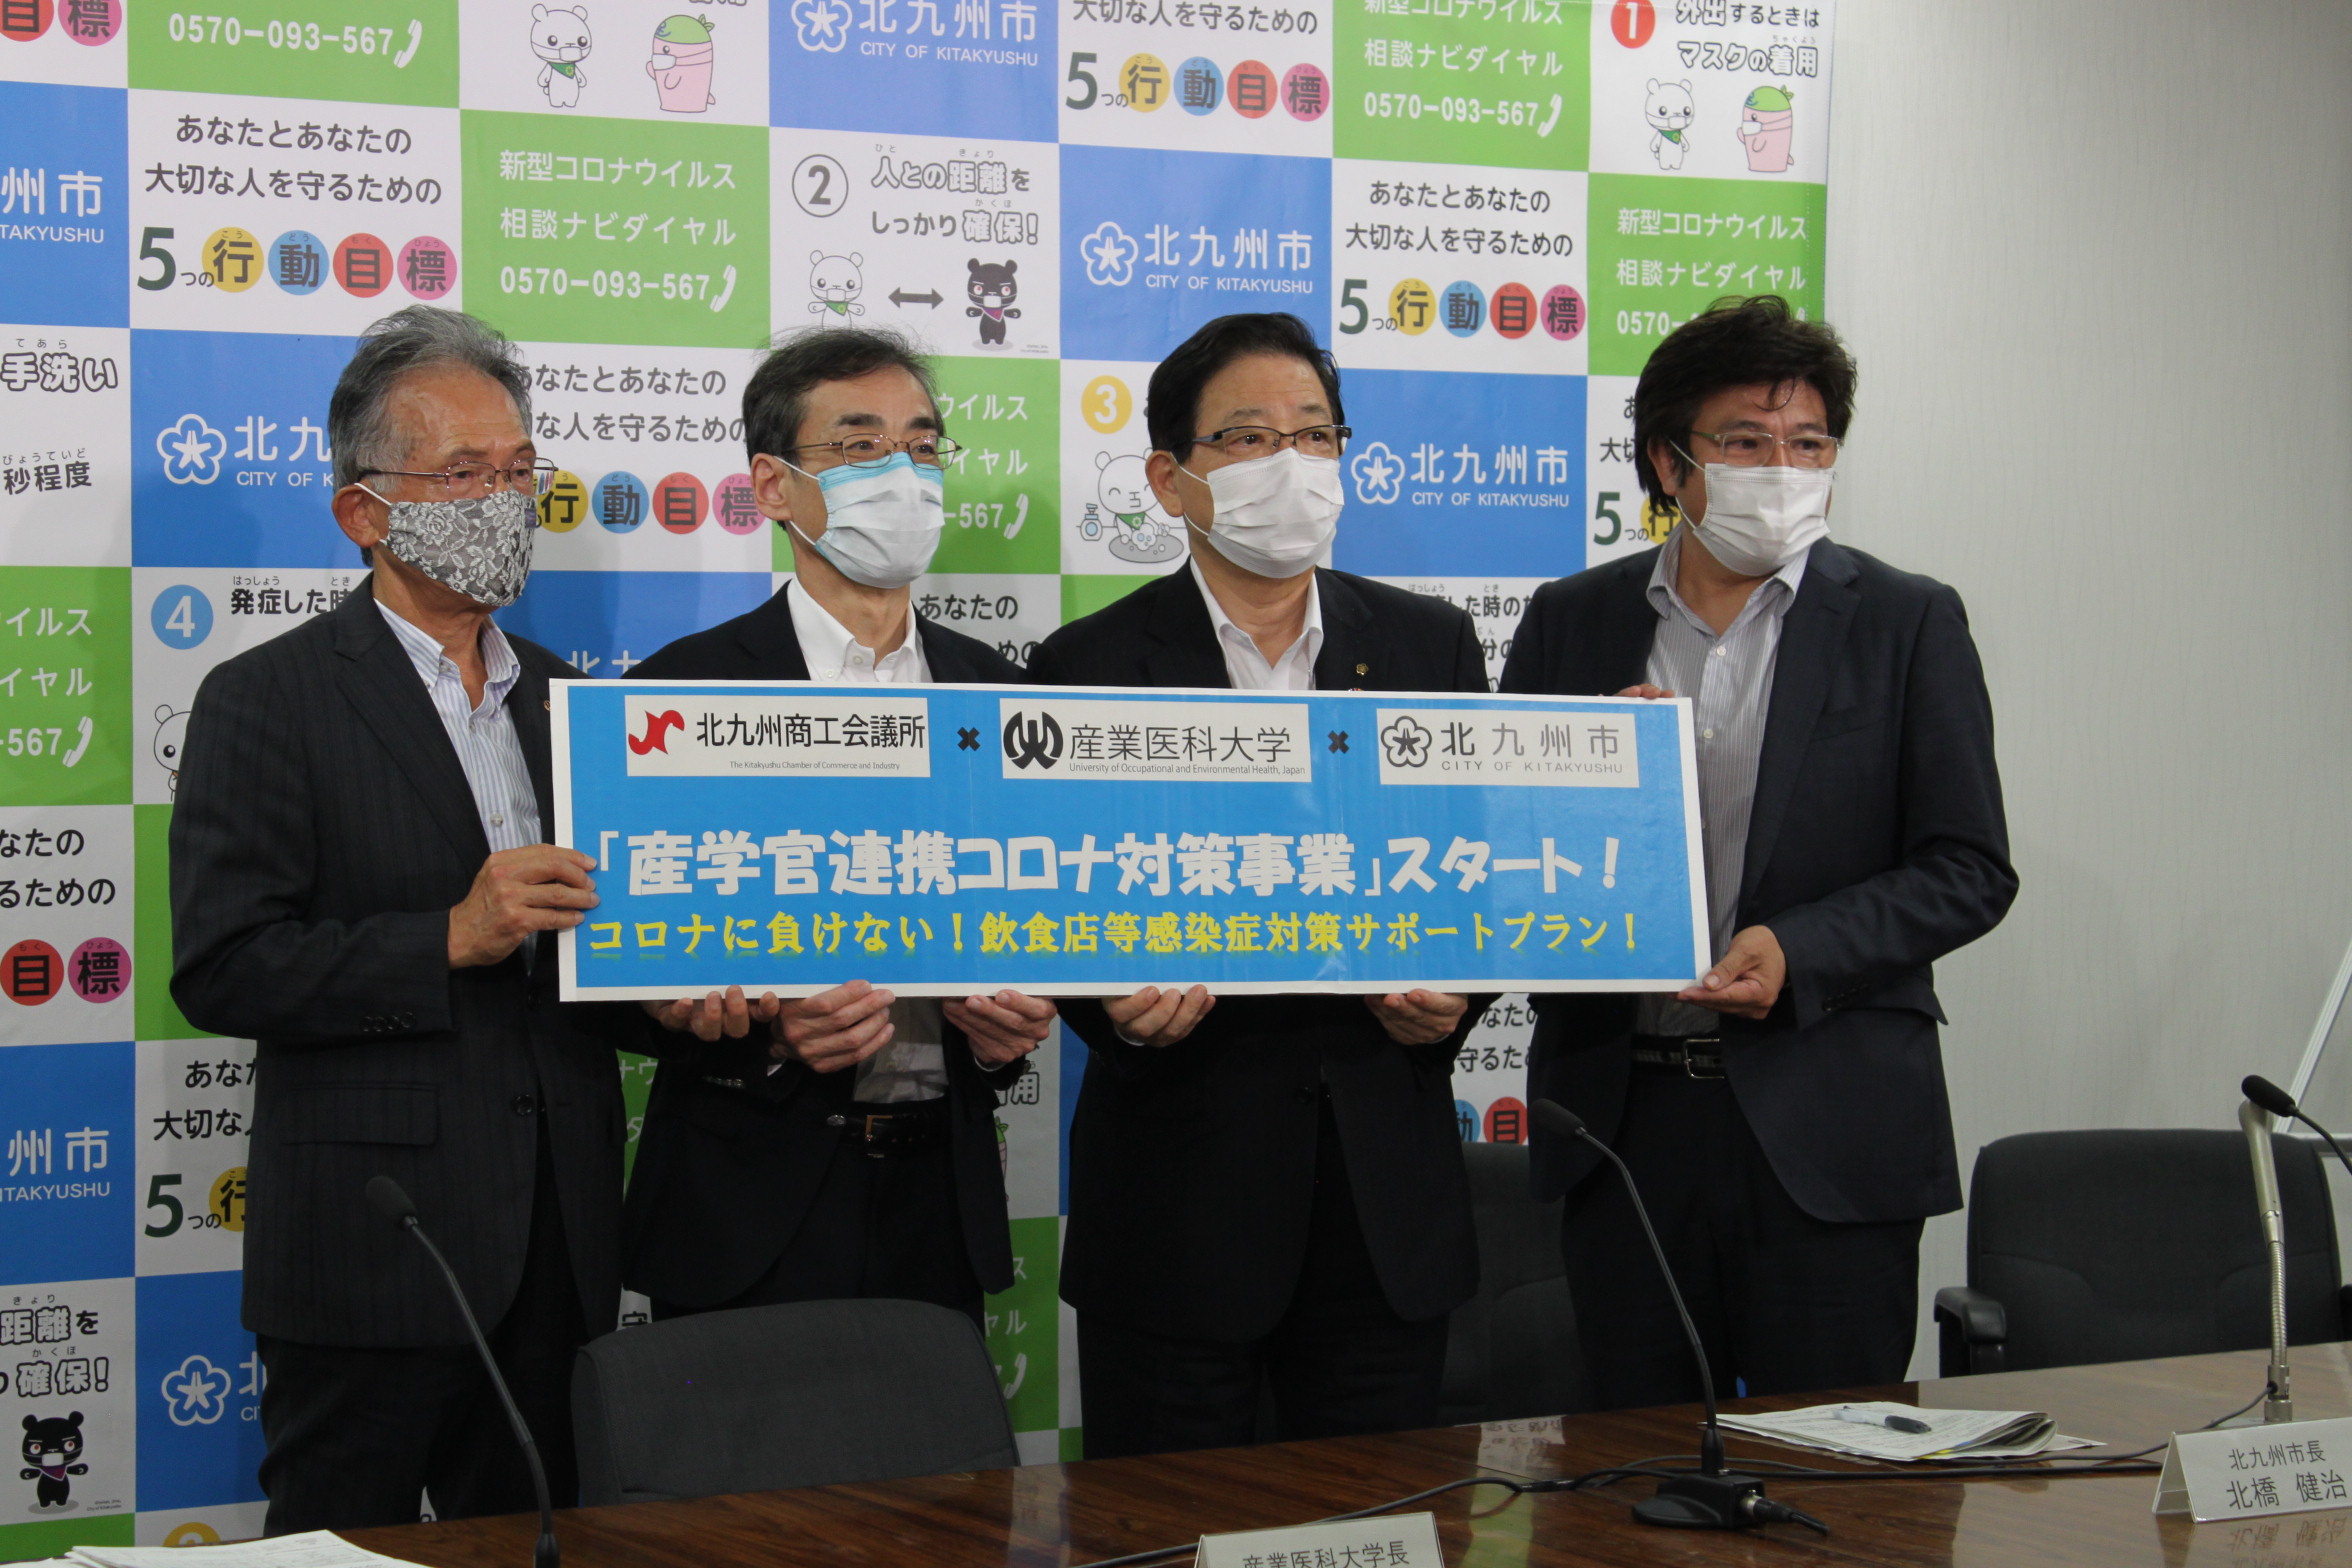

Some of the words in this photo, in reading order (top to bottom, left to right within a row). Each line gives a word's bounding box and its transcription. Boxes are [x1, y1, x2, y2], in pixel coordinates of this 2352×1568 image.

[3, 0, 110, 37] 目標
[858, 0, 1037, 42] 北九州市
[1073, 0, 1318, 35] 大切な人を守るための
[1676, 0, 1820, 28] 外出するときは
[169, 13, 394, 56] 0570-093-567
[860, 41, 896, 57] CITY
[906, 44, 928, 59] OF
[937, 46, 1039, 67] KITAKYUSHU
[1364, 38, 1563, 77] 相談ナビダイヤル
[1677, 41, 1818, 78] マスクの着用
[1364, 92, 1539, 128] 0570-093-567
[176, 114, 412, 155] あなたとあなたの
[145, 162, 442, 205] 大切な人を守るための
[499, 149, 737, 190] 新型コロナウイルス
[871, 155, 1030, 195] 人との距離を
[1, 167, 103, 217] 州市
[1369, 180, 1551, 214] あなたとあなたの
[500, 207, 737, 247] 相談ナビダイヤル
[1345, 222, 1573, 257] 大切な人を守るための
[1617, 207, 1807, 240] 新型コロナウイルス
[1144, 223, 1313, 272] 北九州市
[500, 264, 711, 303] 0570-093-567
[1145, 274, 1180, 289] CITY
[1187, 275, 1209, 290] OF
[1216, 276, 1314, 294] KITAKYUSHU
[1616, 258, 1807, 290] 相談ナビダイヤル
[15, 338, 68, 349] てあら
[0, 351, 119, 393] 手洗い
[3, 461, 92, 495] 秒程度
[236, 471, 277, 486] CITY
[288, 472, 313, 487] OF
[1410, 442, 1568, 485] 北九州市
[1412, 491, 1443, 506] CITY
[1451, 492, 1471, 506] OF
[1478, 492, 1569, 508] KITAKYUSHU
[233, 575, 280, 586] はっしょう
[696, 712, 925, 749] 北九州商工会議所
[1069, 723, 1292, 763] 産業医科大学
[1440, 721, 1619, 759] 北九州市
[729, 761, 743, 769] The
[744, 761, 781, 770] Kitakyushu
[782, 761, 812, 769] Chamber
[813, 761, 821, 769] of
[872, 762, 900, 771] Industry
[1069, 763, 1109, 774] University
[1111, 763, 1120, 772] of
[1121, 763, 1174, 775] Occupational
[1176, 764, 1191, 773] and
[1193, 764, 1250, 774] Environmental
[1252, 765, 1281, 775] Health,
[1282, 766, 1305, 777] Japan
[1441, 760, 1482, 771] CITY
[1494, 761, 1512, 771] OF
[1524, 762, 1623, 774] KITAKYUSHU
[13, 951, 120, 997] 目標
[1457, 1045, 1529, 1073] 守るた
[153, 1108, 251, 1141] 大切な
[8, 1126, 109, 1177] 州市
[0, 1305, 98, 1346] 距離を
[2228, 1440, 2326, 1471] 北九州市長
[2226, 1476, 2280, 1510] 北橋
[2296, 1469, 2348, 1504] 健治
[1242, 1540, 1411, 1568] 産業医科大学長
